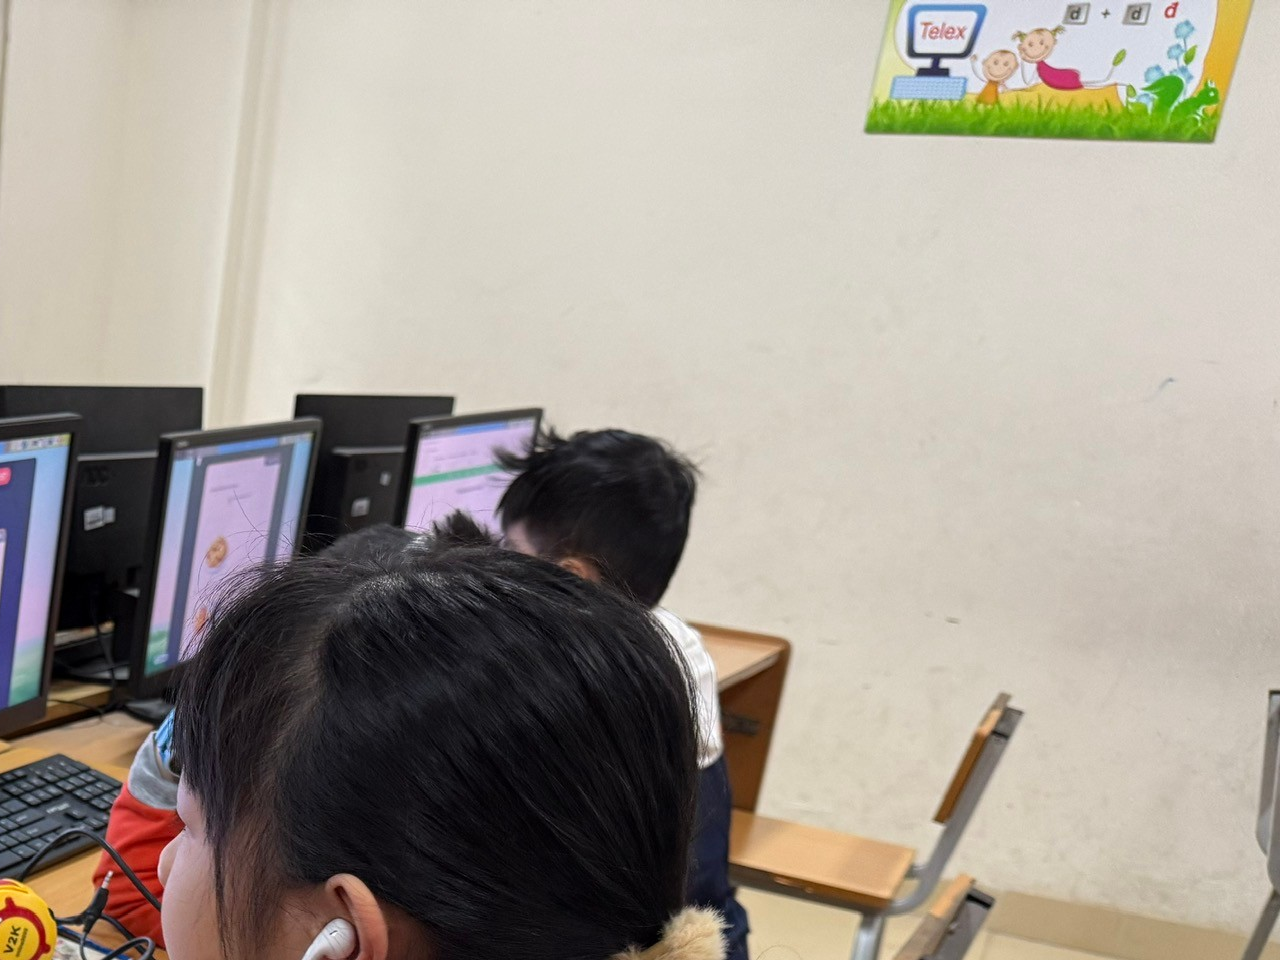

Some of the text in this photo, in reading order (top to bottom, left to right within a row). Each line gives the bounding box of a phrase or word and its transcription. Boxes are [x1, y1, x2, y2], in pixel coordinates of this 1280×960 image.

[1070, 6, 1080, 20] d
[1131, 7, 1142, 20] d
[920, 21, 968, 40] Telex
[3, 925, 21, 954] V2K
